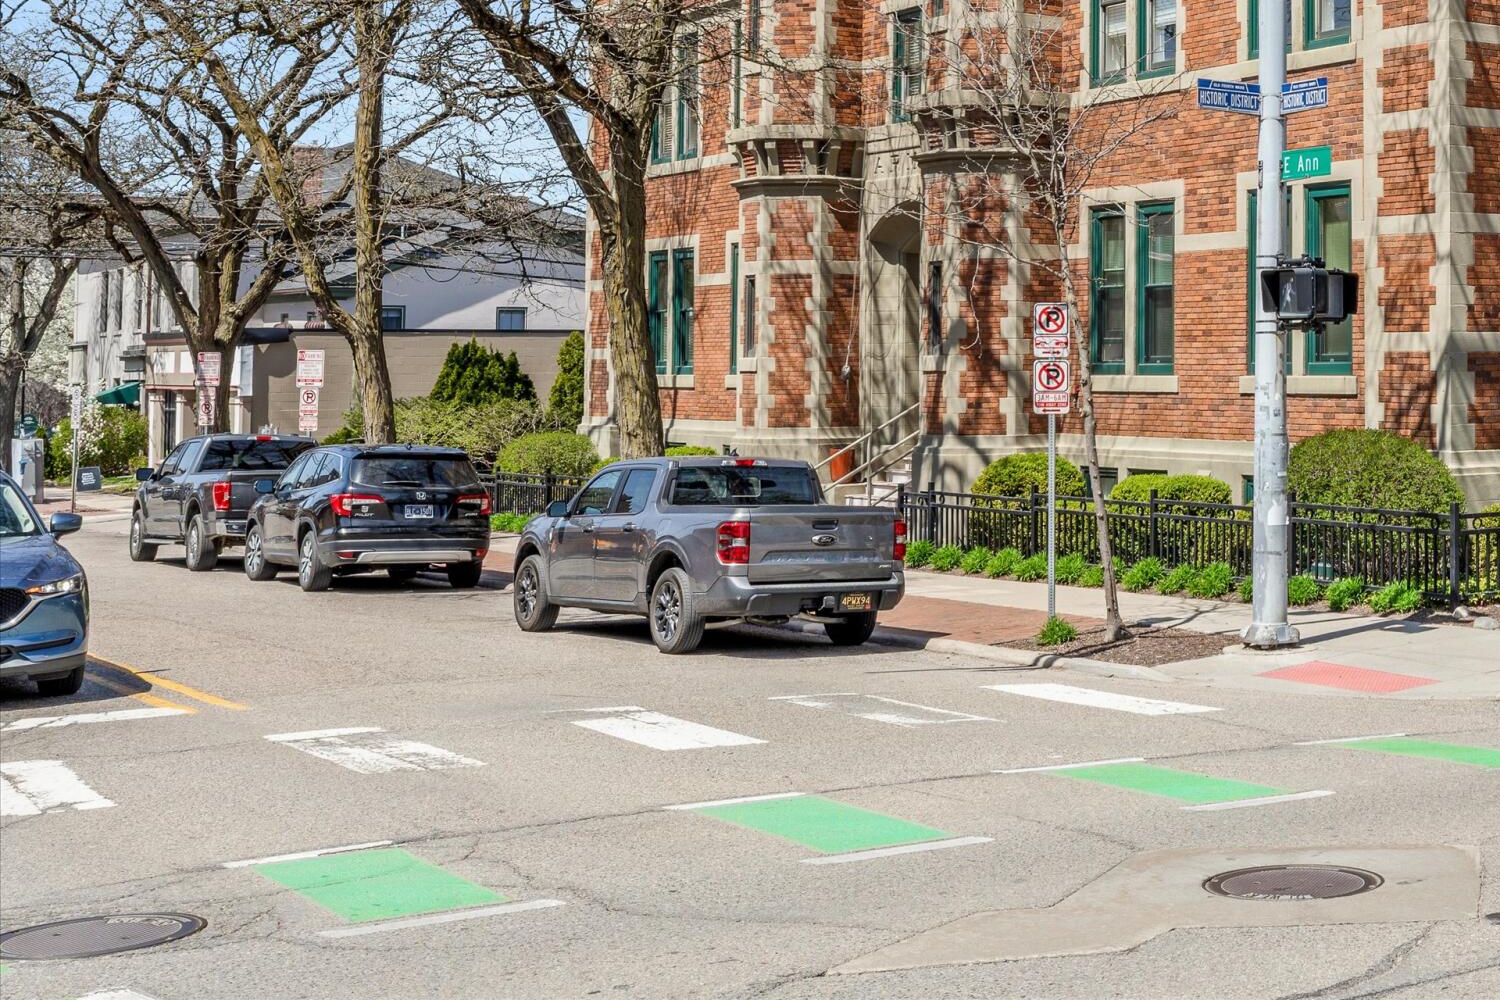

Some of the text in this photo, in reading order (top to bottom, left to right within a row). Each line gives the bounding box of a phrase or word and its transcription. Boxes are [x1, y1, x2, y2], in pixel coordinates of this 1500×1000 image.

[1200, 90, 1258, 110] HISTORIC DISTRICT
[1284, 89, 1326, 109] HISTORIC DISTRICT
[1284, 155, 1319, 173] E Ann
[842, 596, 871, 606] 4PWX94
